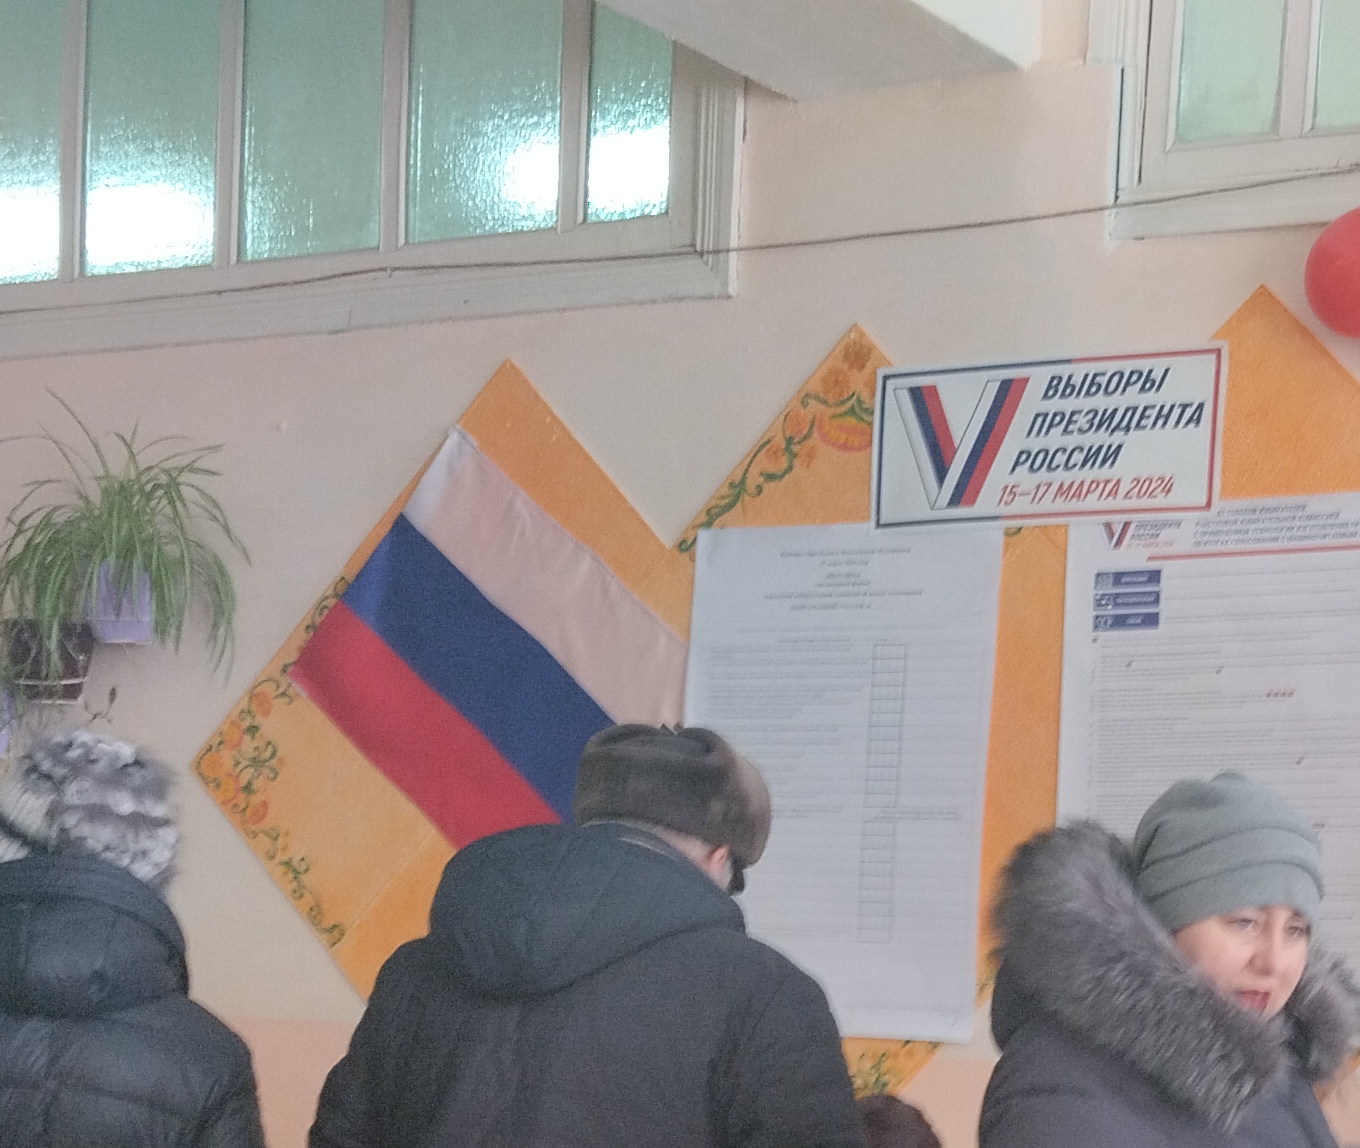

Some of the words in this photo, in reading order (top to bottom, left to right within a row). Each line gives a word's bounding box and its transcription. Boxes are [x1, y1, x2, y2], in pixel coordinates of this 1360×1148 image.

[1041, 367, 1171, 402] ВЫБОРЫ
[1025, 401, 1207, 440] ПРЕЗИДЕНТА
[1008, 442, 1125, 476] РОССИИ
[1050, 476, 1121, 505] МАРТА
[1124, 474, 1175, 501] 2024
